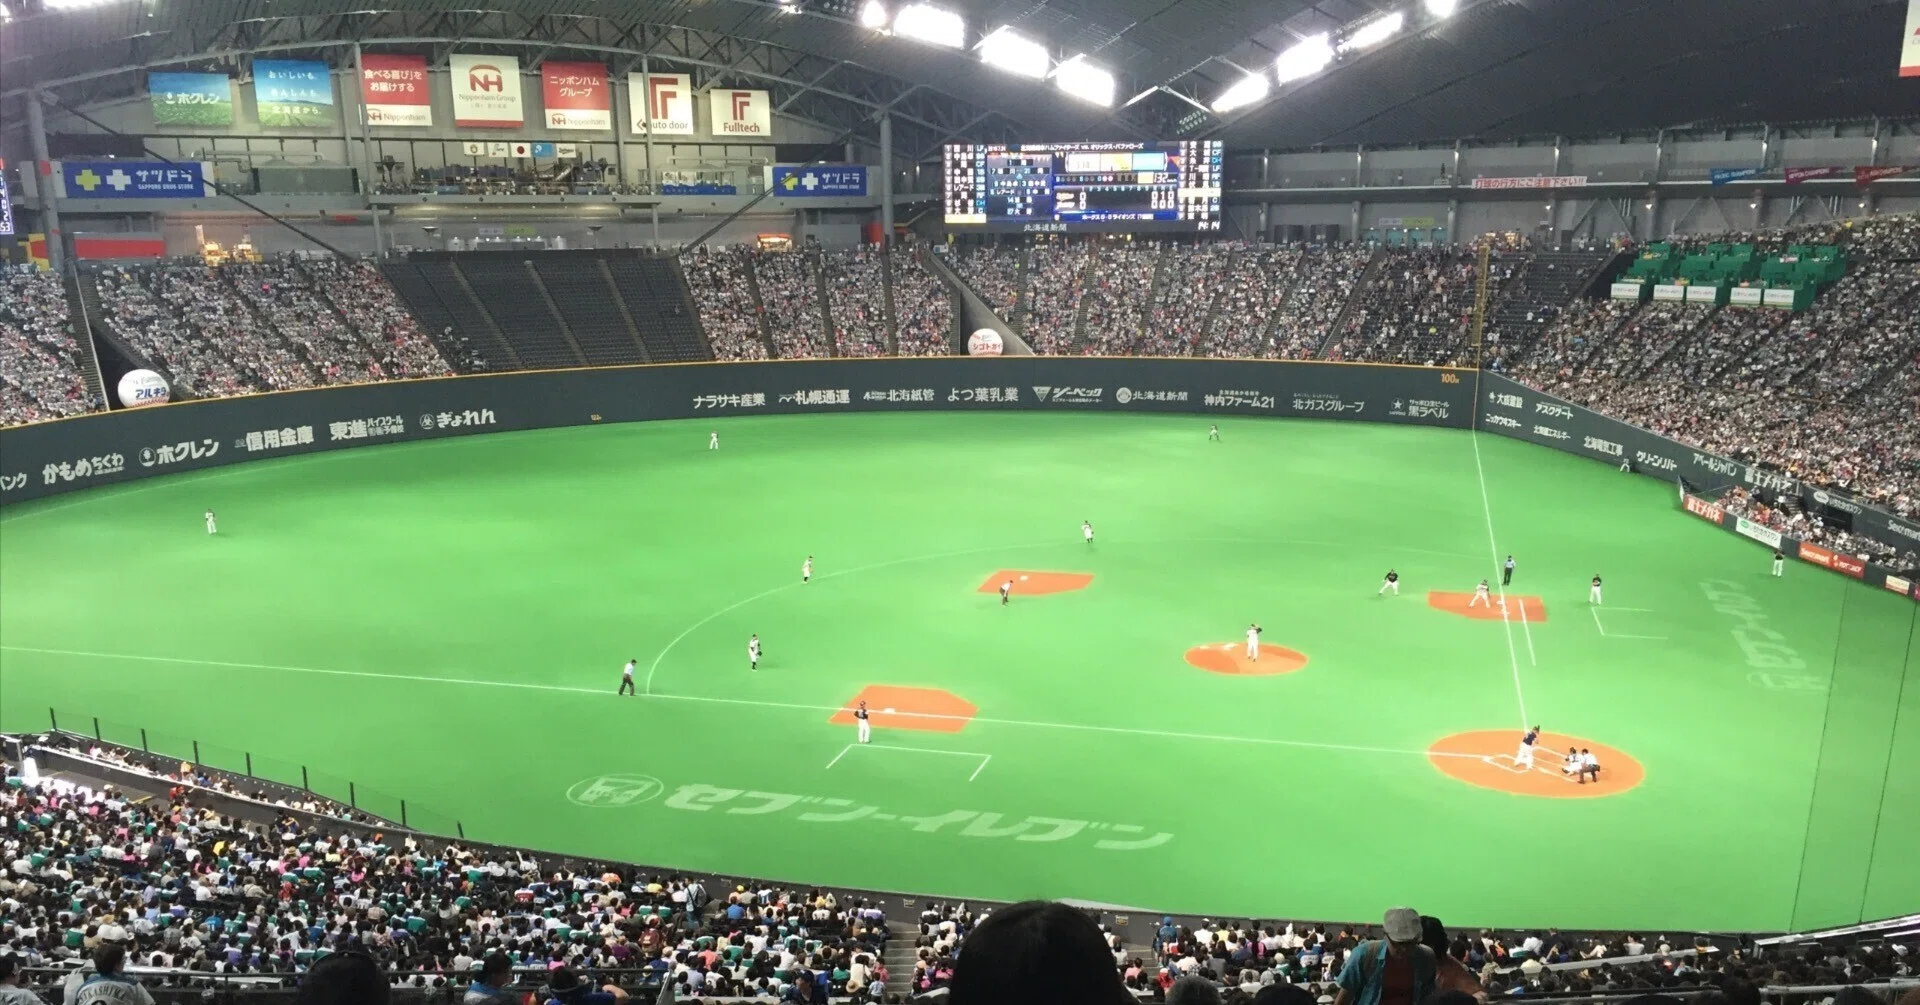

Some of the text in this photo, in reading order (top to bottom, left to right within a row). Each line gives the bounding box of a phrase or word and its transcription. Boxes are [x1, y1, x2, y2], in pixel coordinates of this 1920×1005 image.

[370, 82, 414, 92] お届けする
[550, 76, 599, 86] ニッポンハム
[177, 92, 219, 105] ホクレン
[459, 93, 516, 103] Nipponham Group
[559, 88, 592, 98] グループ
[384, 113, 426, 122] Nipponham
[668, 120, 689, 130] door
[723, 122, 760, 133] Fulltech
[1023, 223, 1068, 231] 北海道新聞
[795, 389, 850, 405] 札幌通運
[887, 389, 935, 402] 北海紙管
[948, 387, 1019, 403] よつ葉乳業
[1052, 386, 1103, 399] ジーベック
[1132, 391, 1189, 401] 北海道新聞
[693, 393, 766, 409] ナラサキ産業
[1204, 394, 1275, 408] 神内ファーム21
[1292, 399, 1365, 413] 北ガスグループ
[436, 408, 496, 429] ぎょれん
[1408, 405, 1449, 419] 黒ラベル
[367, 415, 404, 428] ハイスクール
[329, 419, 368, 441] 東進
[245, 425, 315, 451] 信用金庫
[157, 439, 219, 465] ホクレン
[1636, 450, 1678, 472] クリーンリバー
[1744, 467, 1793, 492] 富士メガネ
[1687, 499, 1721, 522] 富士メガネ
